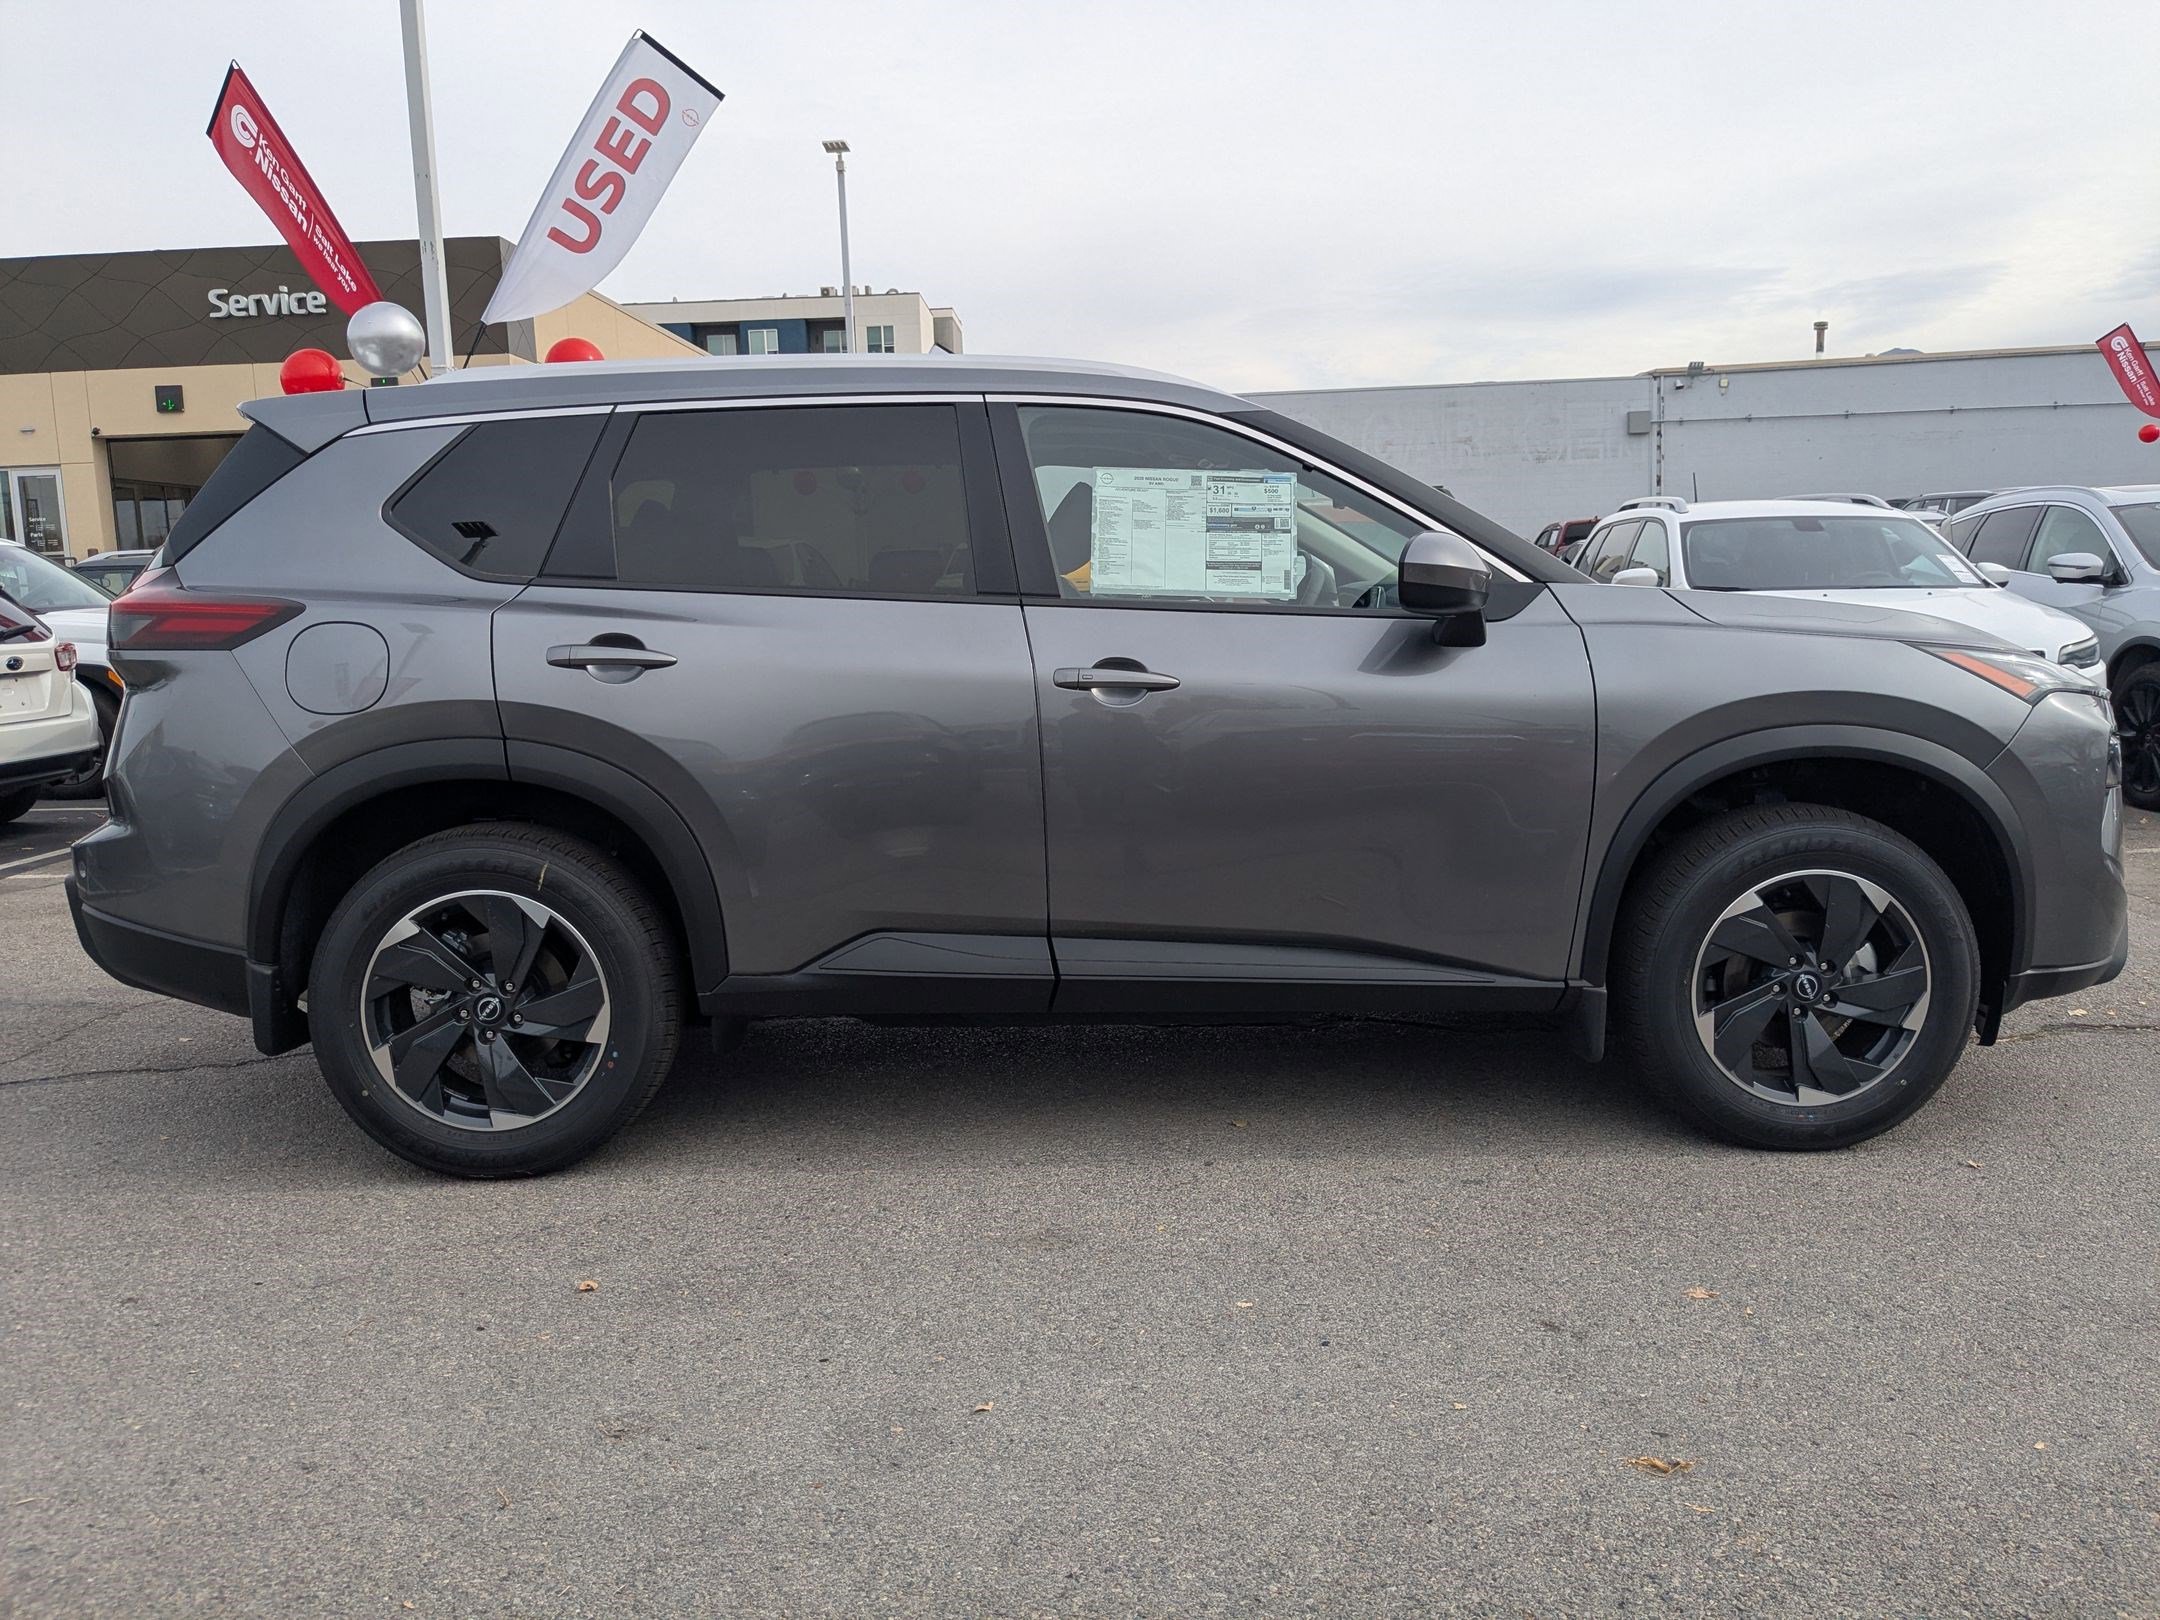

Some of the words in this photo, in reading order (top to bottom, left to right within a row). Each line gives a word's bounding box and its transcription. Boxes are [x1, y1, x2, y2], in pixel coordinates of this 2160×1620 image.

[259, 133, 280, 172] Ken
[547, 77, 672, 254] USED
[255, 147, 308, 232] Nissan
[313, 234, 323, 251] we
[322, 249, 339, 274] hear
[337, 273, 350, 293] you
[314, 224, 334, 257] Salt
[335, 254, 357, 292] Lake
[208, 286, 327, 319] Service
[2117, 351, 2137, 383] Nissan
[1213, 485, 1225, 495] 31
